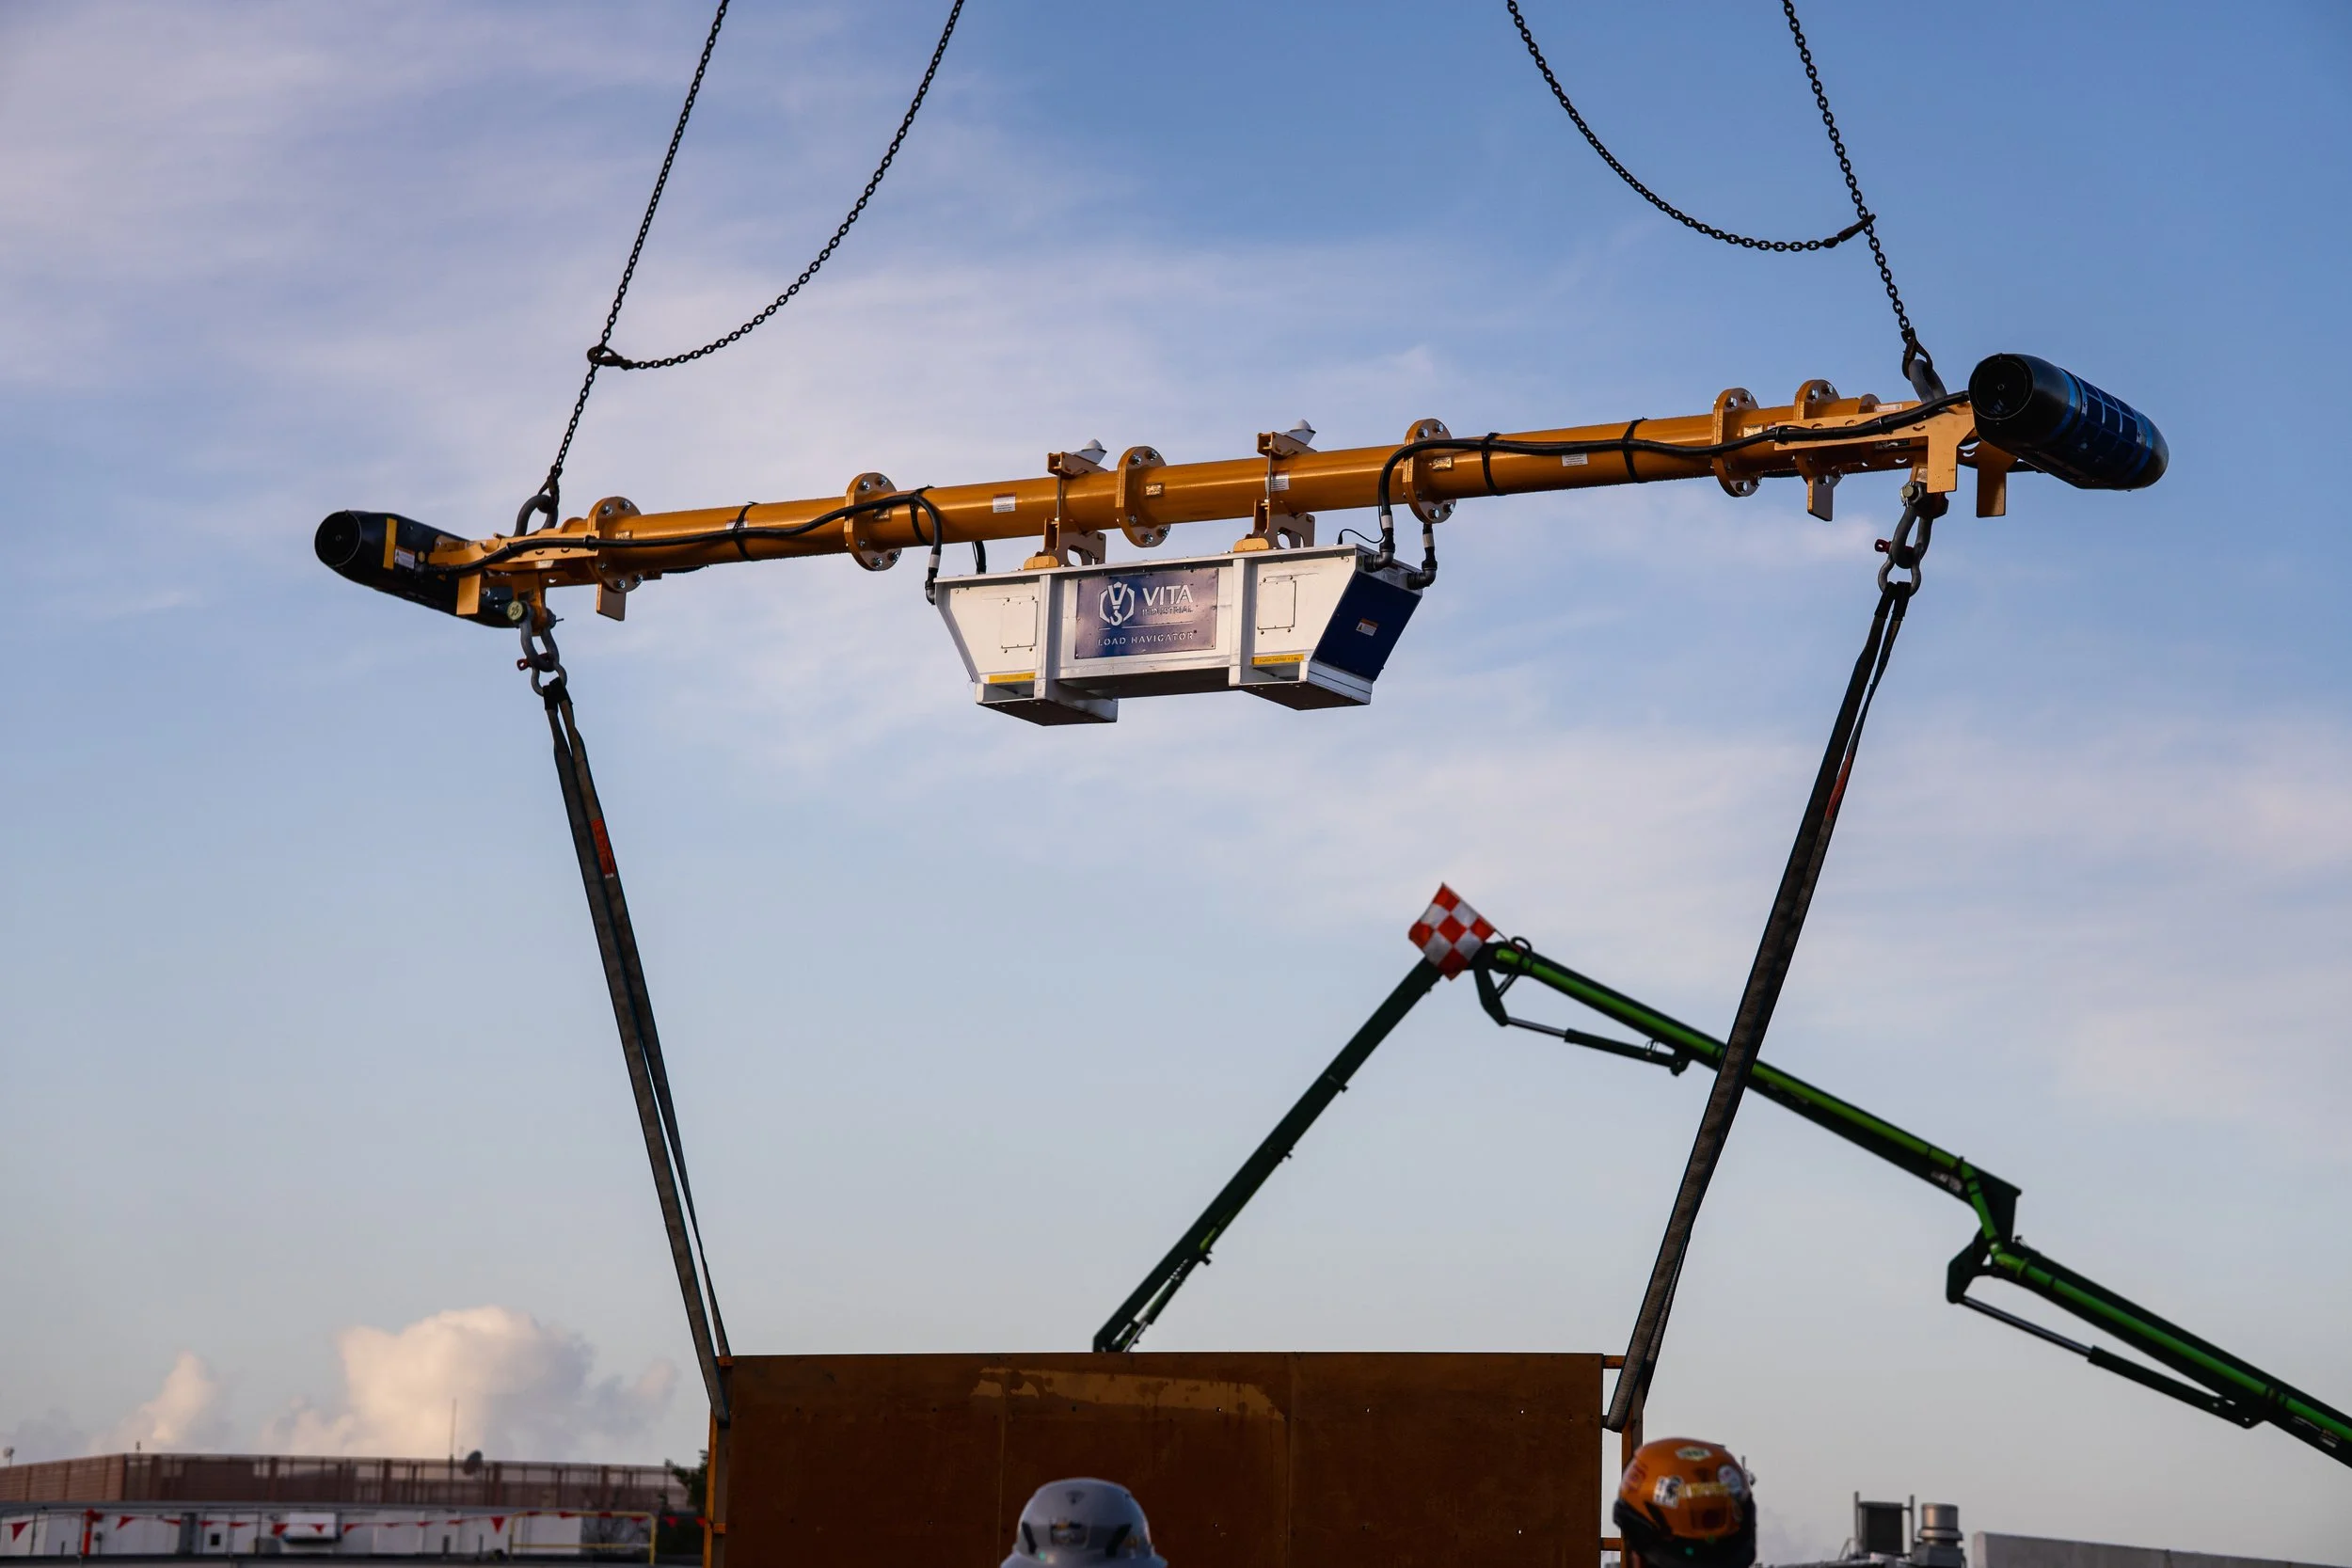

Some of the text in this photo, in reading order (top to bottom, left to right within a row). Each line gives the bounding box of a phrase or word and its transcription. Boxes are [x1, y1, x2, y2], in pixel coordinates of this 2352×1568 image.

[1142, 585, 1194, 607] VITA
[1142, 606, 1193, 617] INDUSTRIAL
[1098, 632, 1193, 647] LOAD NAVIGATOR
